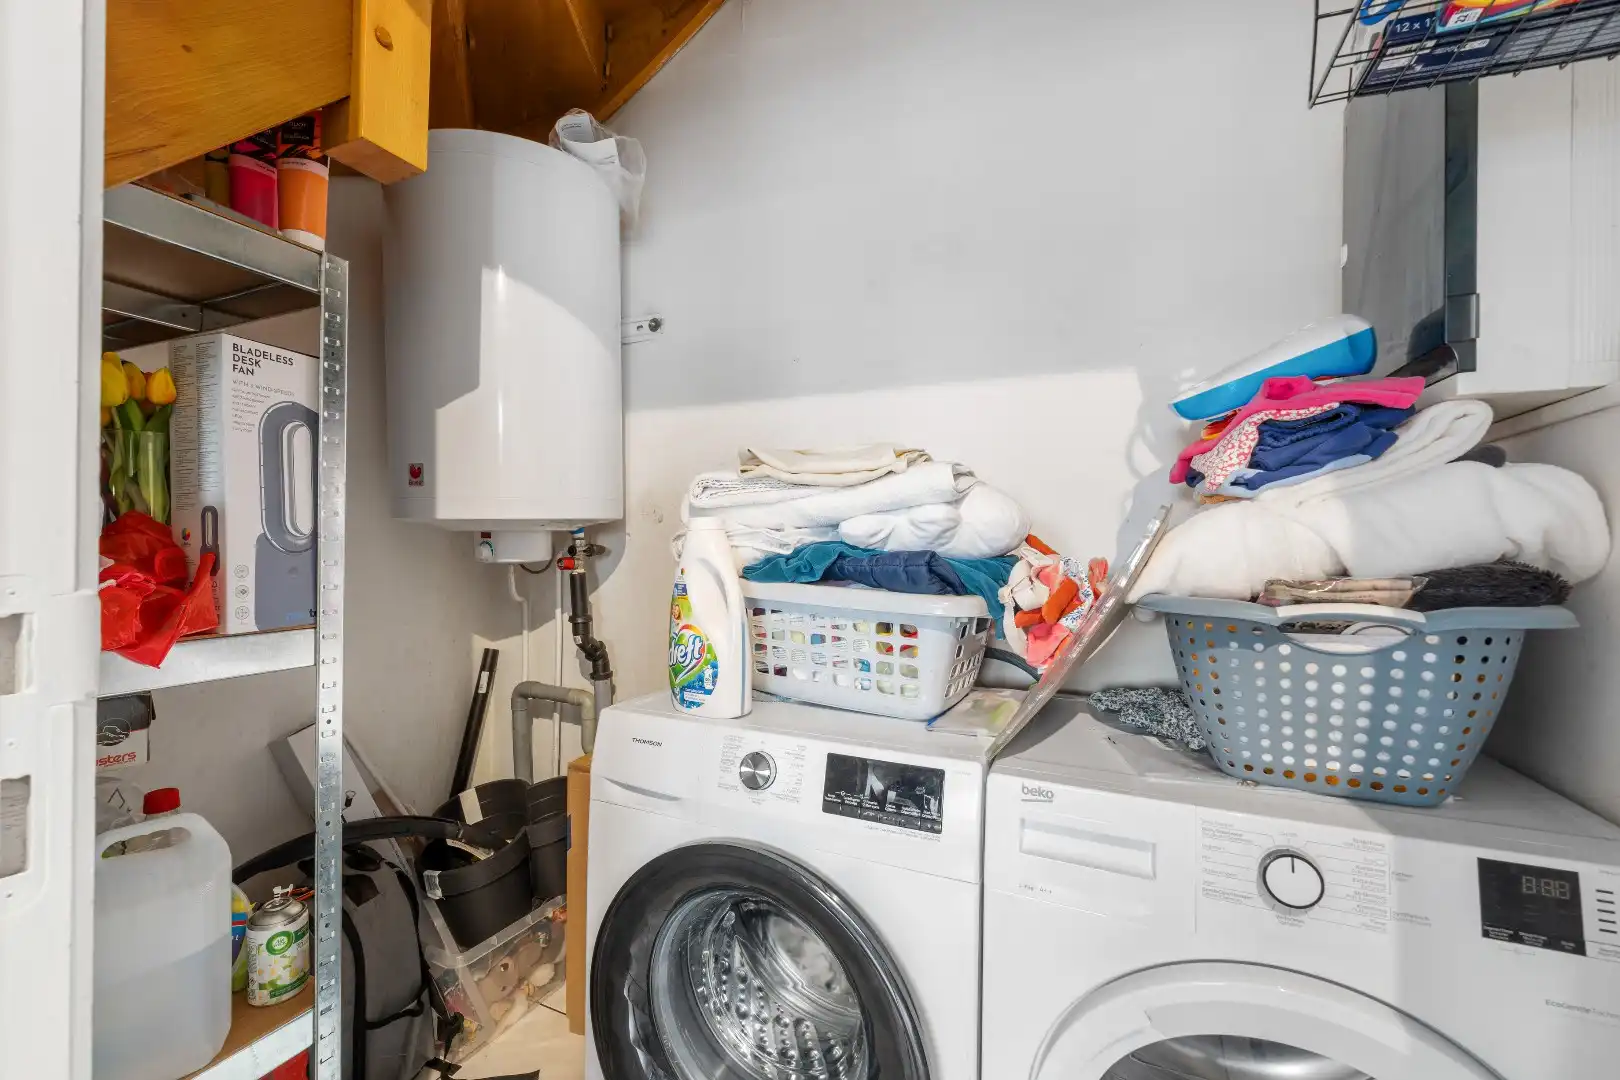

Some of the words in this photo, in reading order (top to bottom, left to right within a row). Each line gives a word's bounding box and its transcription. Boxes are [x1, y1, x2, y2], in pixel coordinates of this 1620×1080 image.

[1396, 22, 1410, 33] 12
[1413, 21, 1421, 30] x
[232, 342, 294, 366] BLADELESS
[232, 353, 262, 369] DESK
[232, 364, 255, 376] FAN
[669, 634, 703, 667] dreft
[632, 737, 663, 747] THOMSON
[1021, 781, 1055, 800] beko
